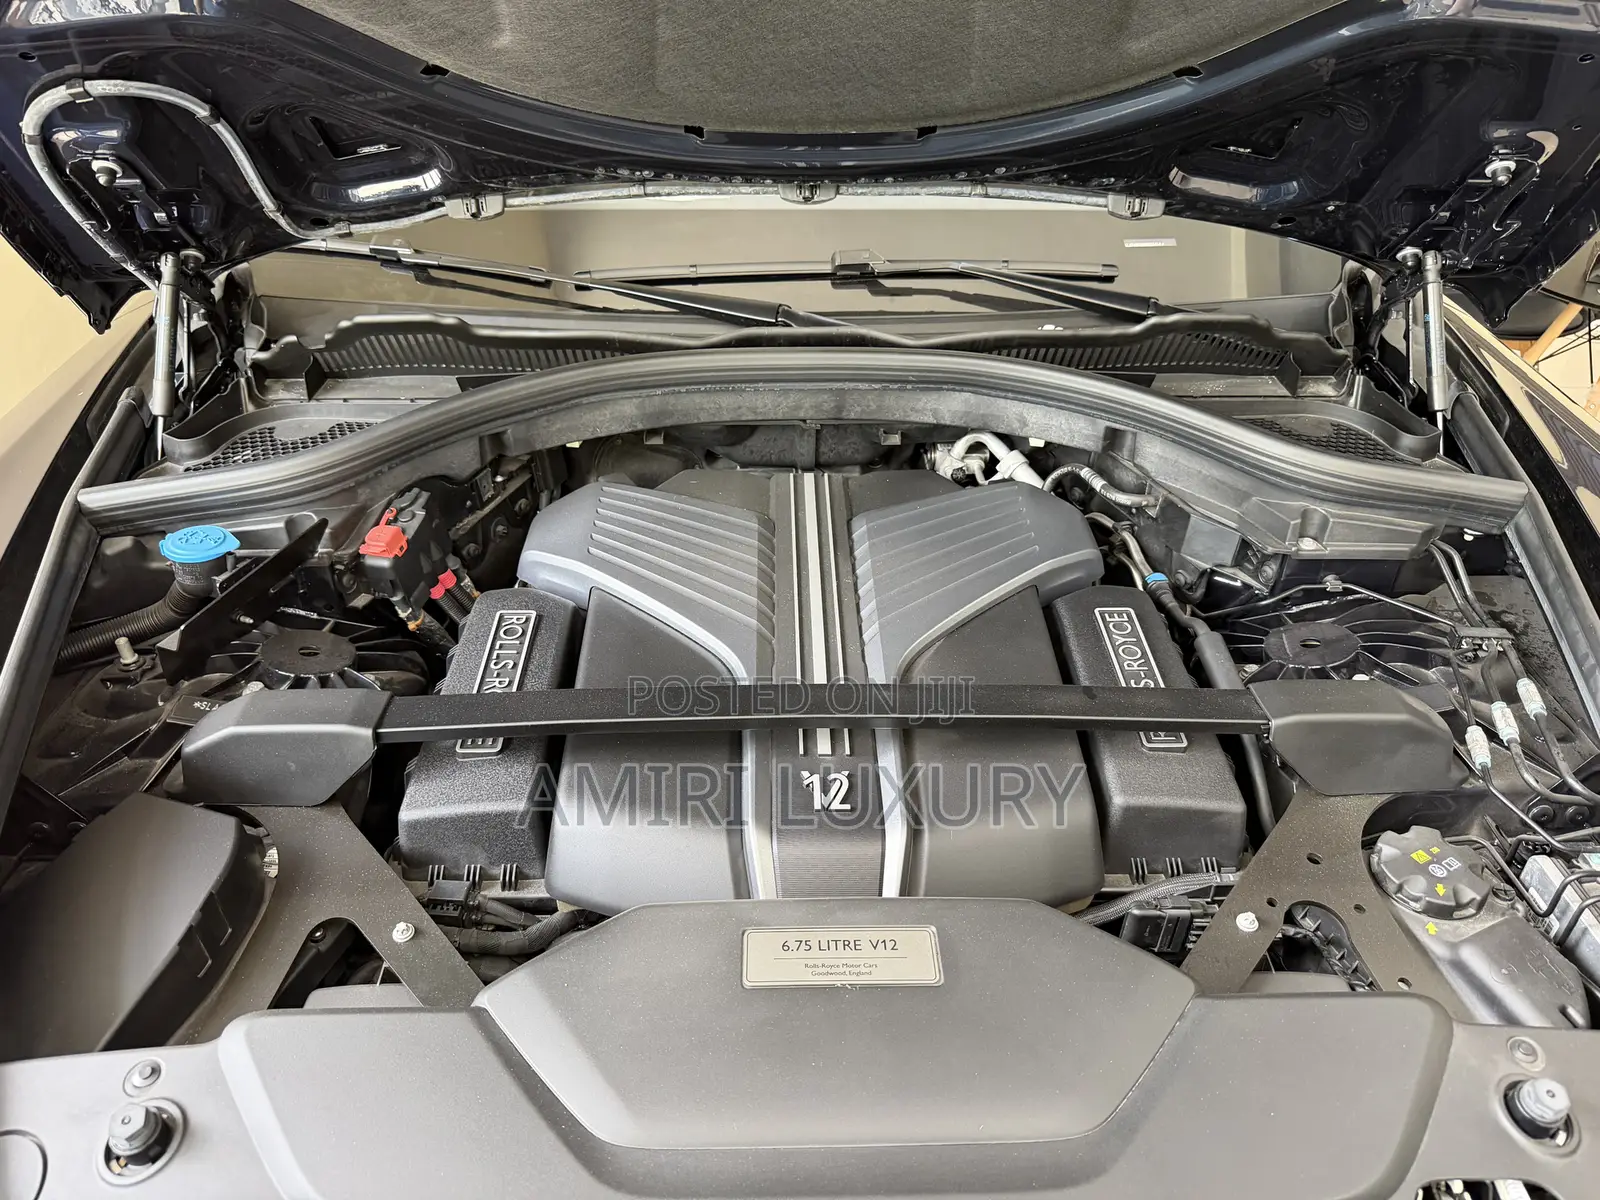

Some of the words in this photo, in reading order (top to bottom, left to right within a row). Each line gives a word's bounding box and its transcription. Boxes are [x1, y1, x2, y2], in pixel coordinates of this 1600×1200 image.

[781, 939, 812, 952] 6.75
[818, 939, 862, 951] LITRE
[869, 938, 899, 951] V12
[804, 962, 841, 970] Rolls-Royce
